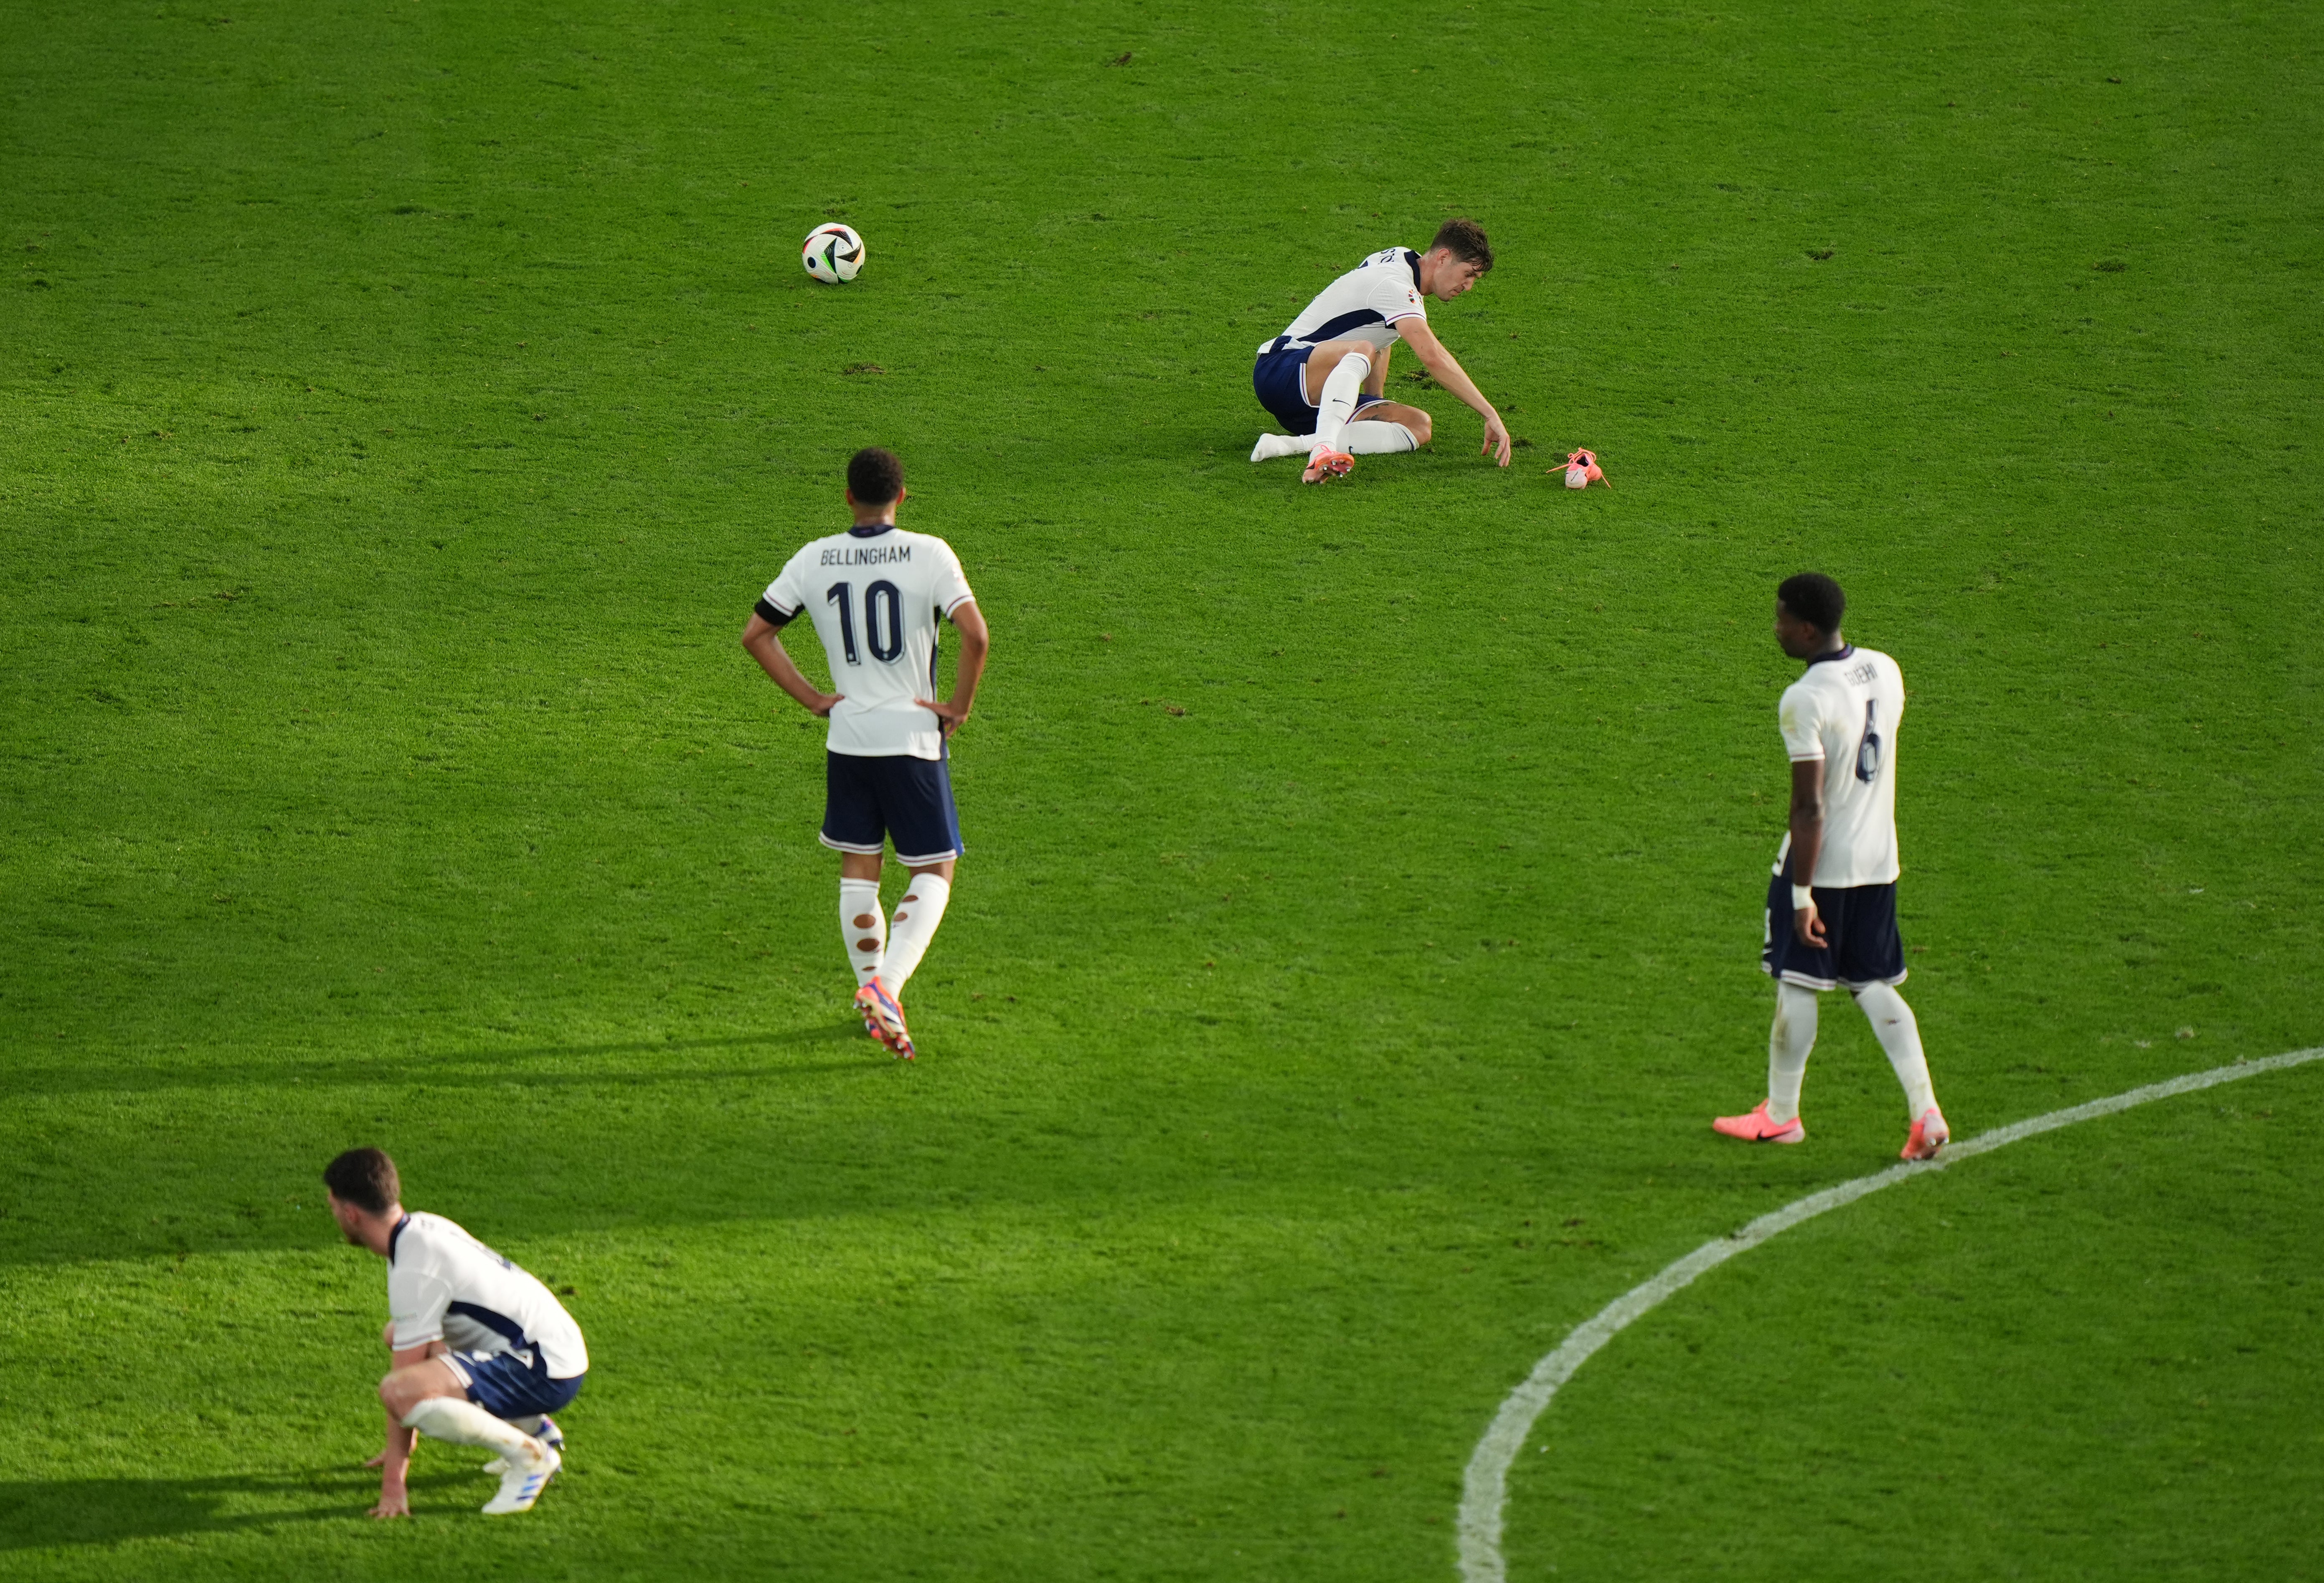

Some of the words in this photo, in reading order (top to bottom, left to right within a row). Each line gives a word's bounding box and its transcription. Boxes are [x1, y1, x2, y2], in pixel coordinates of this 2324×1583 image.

[821, 545, 911, 566] BELLINGHAM
[827, 580, 906, 666] 10
[1856, 698, 1882, 784] 6
